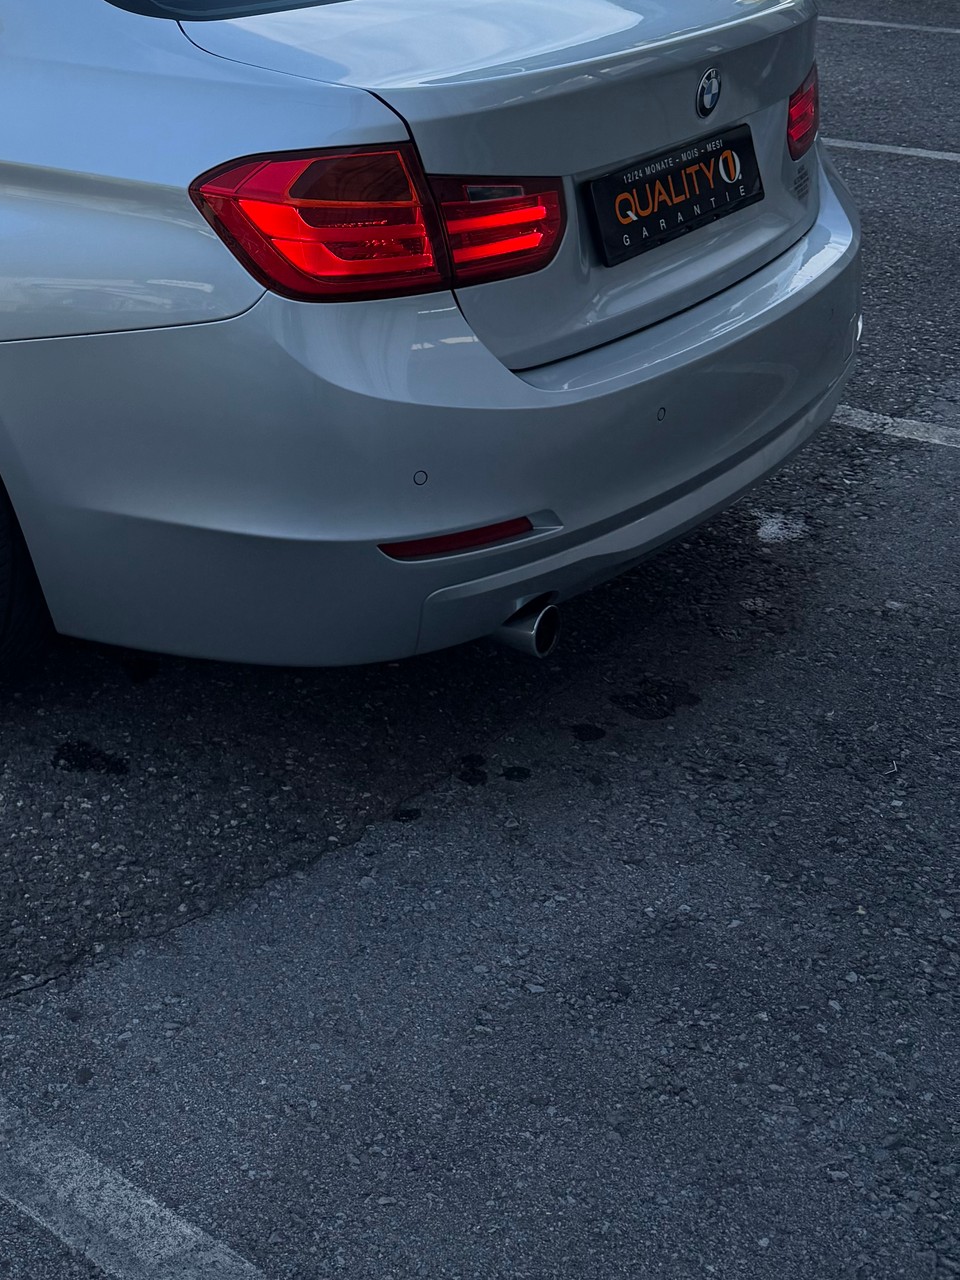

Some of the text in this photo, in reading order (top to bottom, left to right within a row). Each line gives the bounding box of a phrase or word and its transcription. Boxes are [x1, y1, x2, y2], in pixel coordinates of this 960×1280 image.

[623, 169, 643, 184] 12/24
[644, 157, 674, 176] MONATE
[681, 148, 699, 162] MOIS
[706, 139, 723, 153] MESI
[623, 185, 746, 246] GARANTIE
